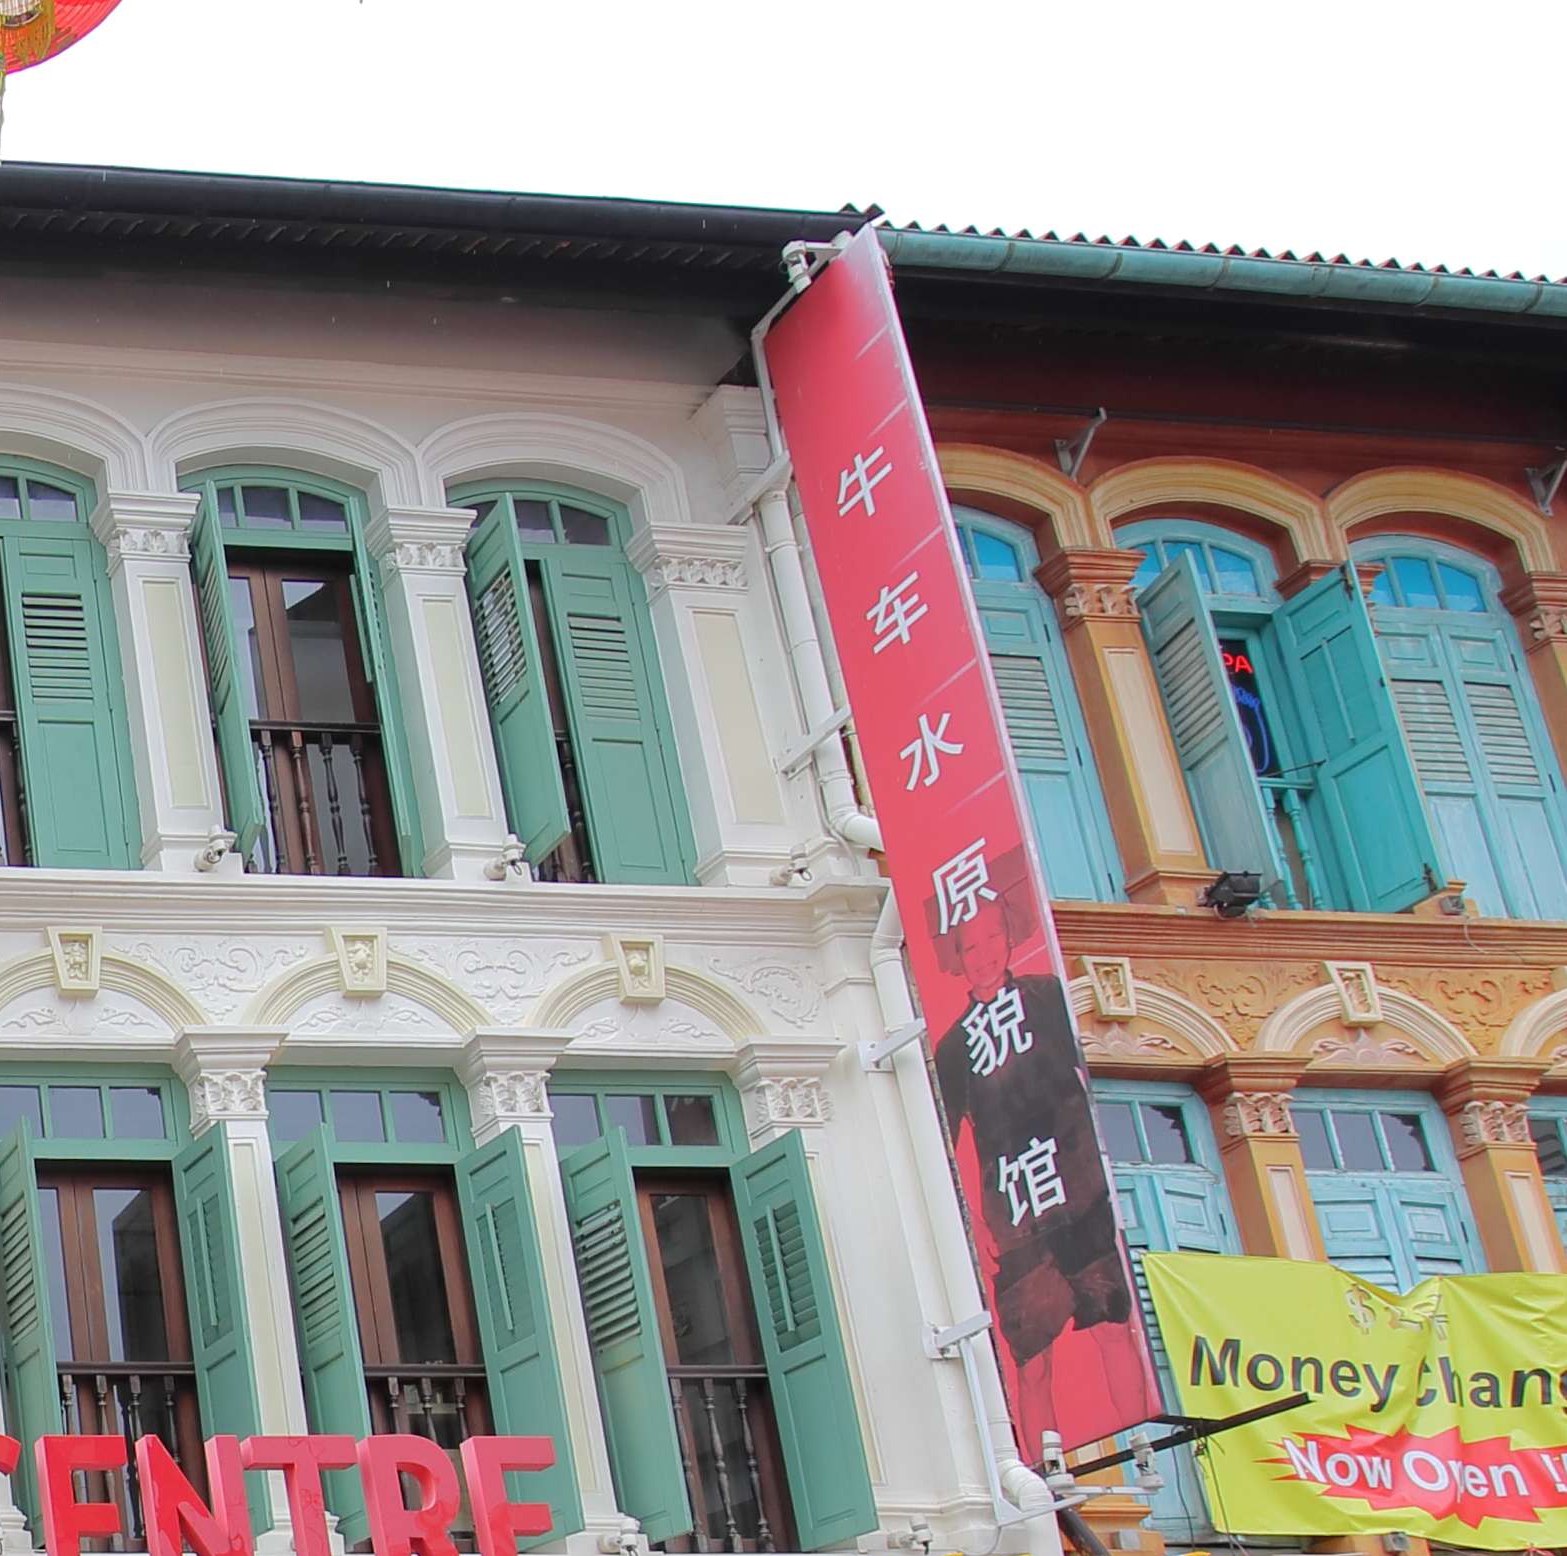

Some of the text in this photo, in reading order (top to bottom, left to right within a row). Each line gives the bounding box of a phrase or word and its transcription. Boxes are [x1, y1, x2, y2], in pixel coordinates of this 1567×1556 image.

[835, 444, 1067, 1229] 牛车水原貌馆
[1190, 1334, 1400, 1413] Money
[1282, 1436, 1393, 1491] Now
